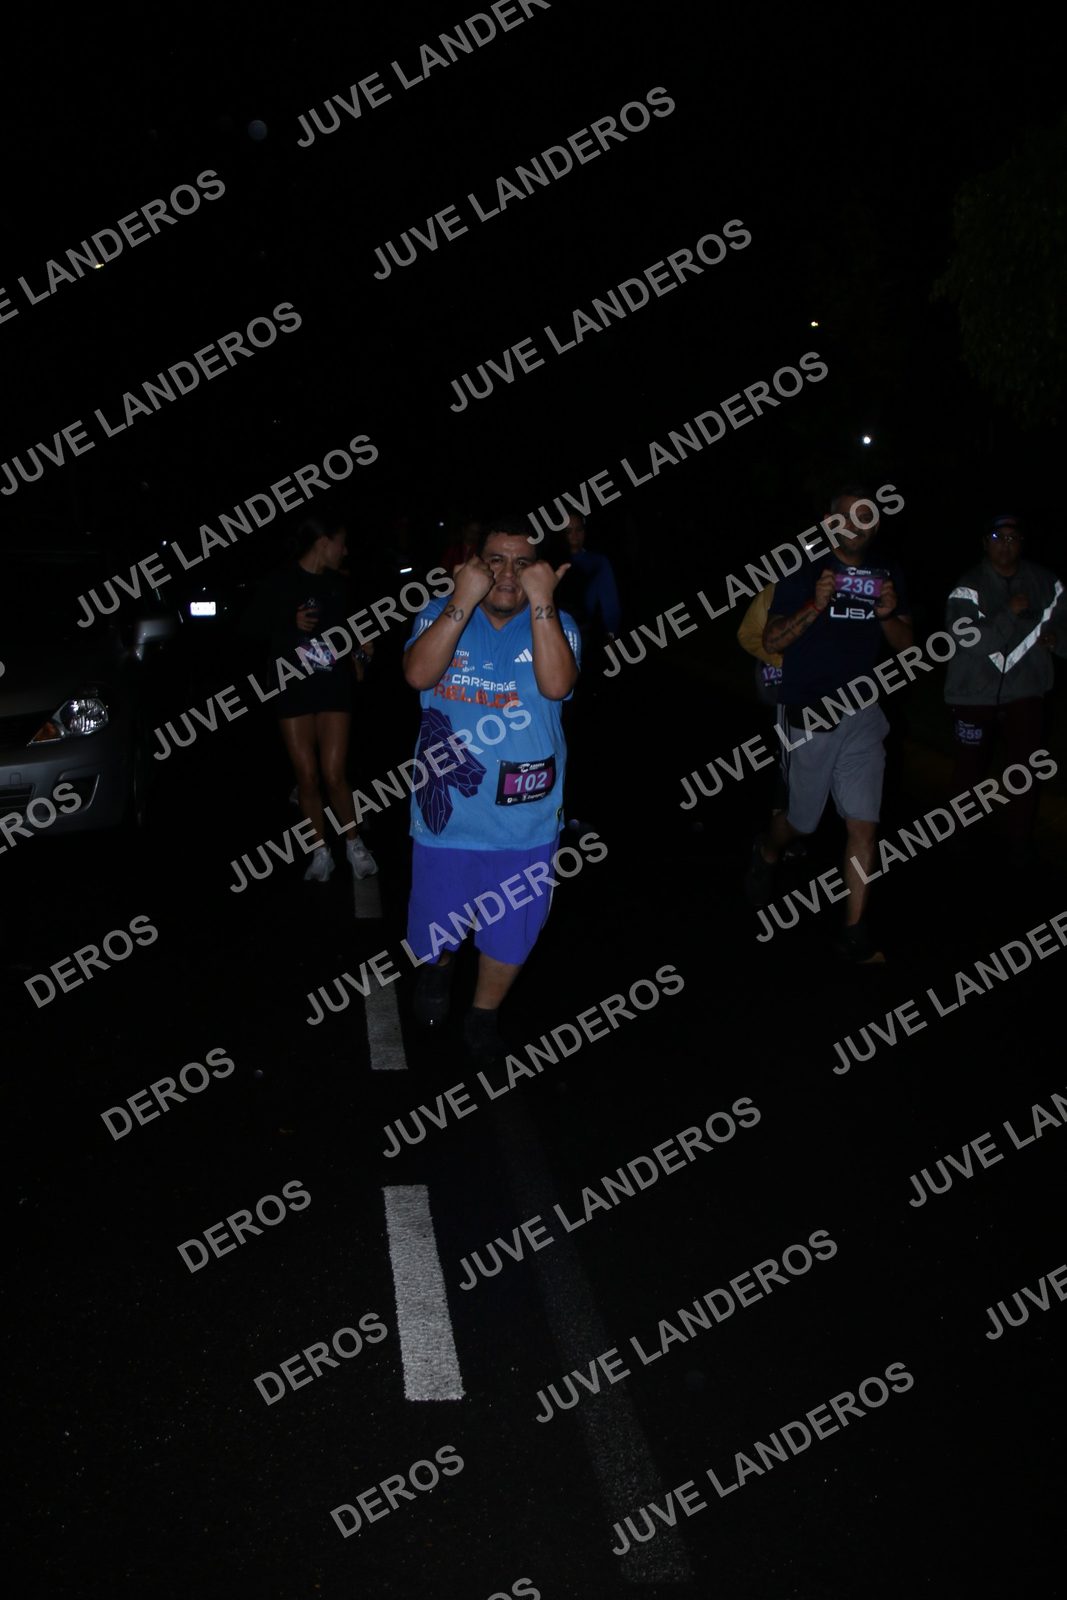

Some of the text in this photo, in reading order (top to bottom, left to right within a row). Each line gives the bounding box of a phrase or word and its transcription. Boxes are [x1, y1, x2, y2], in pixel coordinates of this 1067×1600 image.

[840, 576, 875, 596] 236
[444, 604, 464, 622] 20
[535, 605, 554, 620] 22
[514, 771, 548, 793] 102
